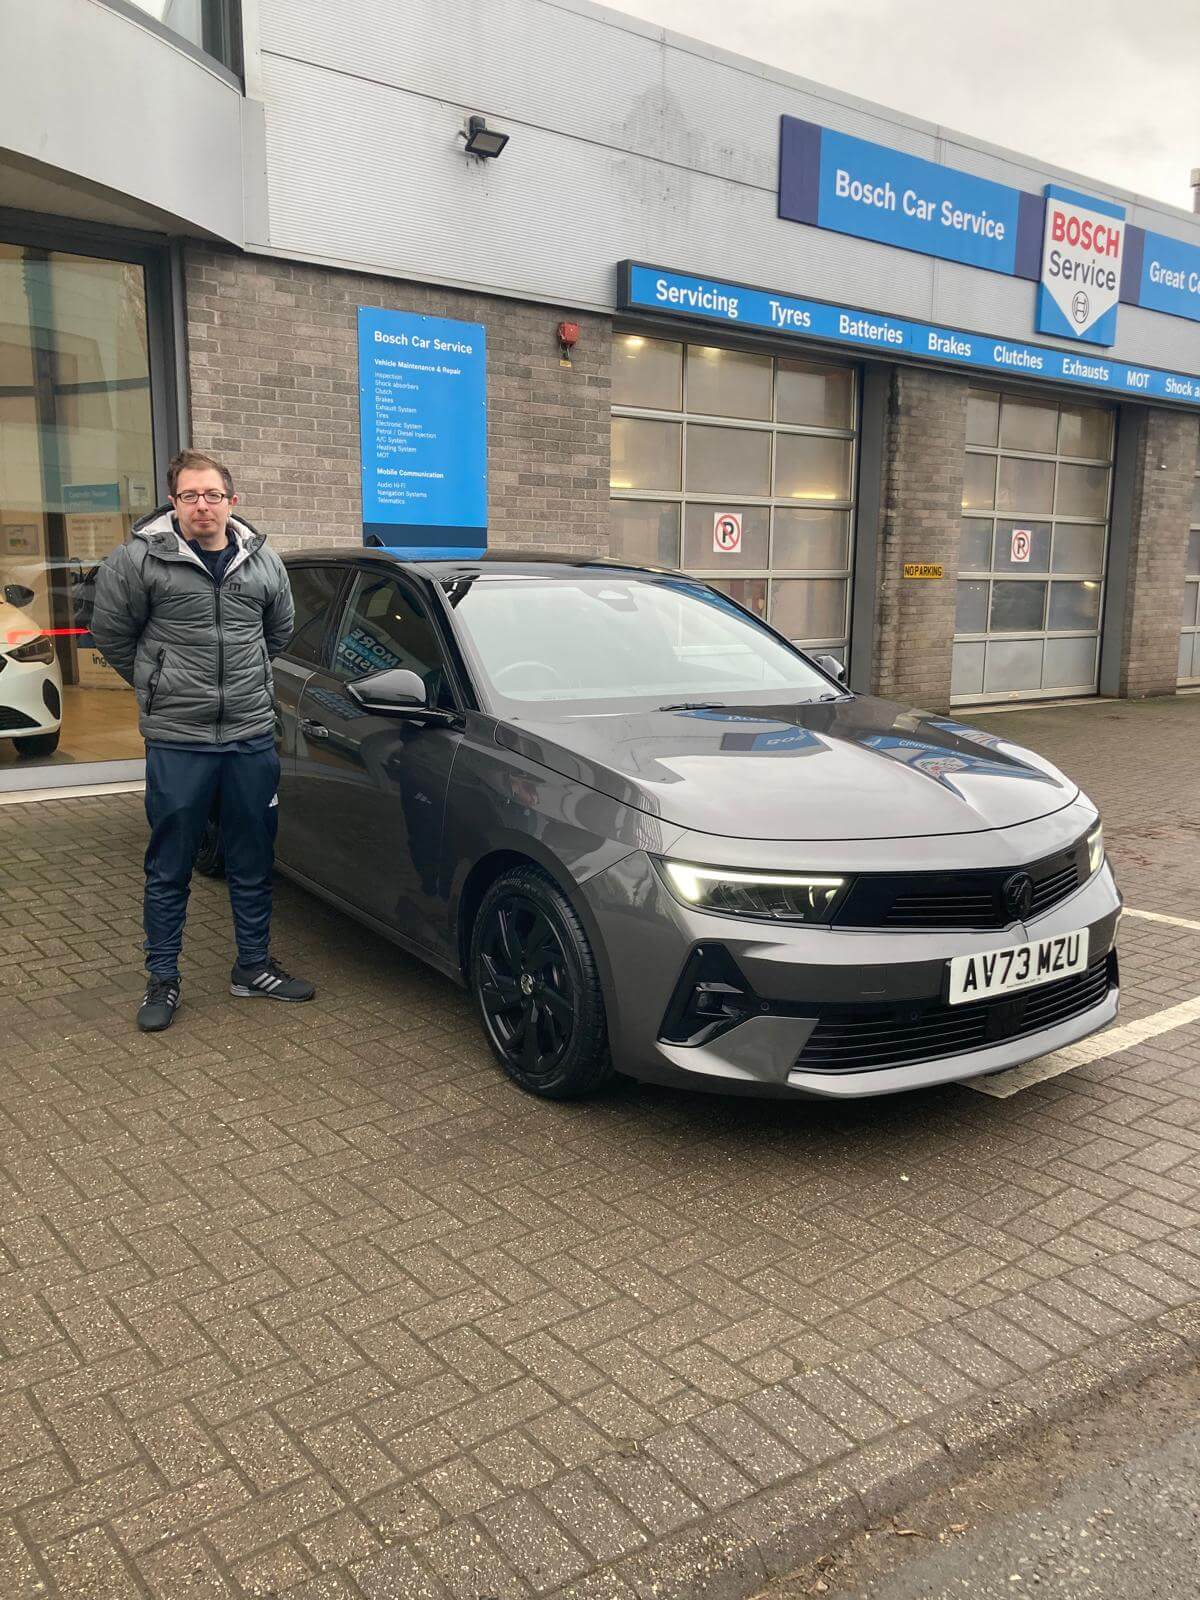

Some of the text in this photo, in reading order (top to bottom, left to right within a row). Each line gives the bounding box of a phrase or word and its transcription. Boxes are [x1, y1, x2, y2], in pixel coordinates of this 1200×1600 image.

[835, 168, 1005, 241] Bosch Car Service
[1051, 210, 1120, 258] BOSCH
[1048, 249, 1116, 291] Service
[1149, 260, 1185, 290] Great
[374, 330, 473, 354] Bosch Car Service
[656, 278, 739, 319] Servicing
[769, 300, 811, 328] Tyres
[839, 314, 904, 345] Batteries
[928, 332, 972, 357] Brakes
[993, 345, 1044, 370] Clutches
[1062, 357, 1110, 381] Exhausts
[1126, 370, 1150, 389] MOT
[1165, 377, 1193, 397] Shock
[374, 358, 397, 368] Vehicle
[397, 361, 436, 373] Maintenance
[442, 366, 461, 376] Repair
[375, 387, 393, 395] Clutch
[375, 395, 394, 404] Brakes
[376, 466, 444, 479] Mobile Communication
[904, 565, 943, 577] NO PARKING
[962, 933, 1081, 993] AV73 MZU
